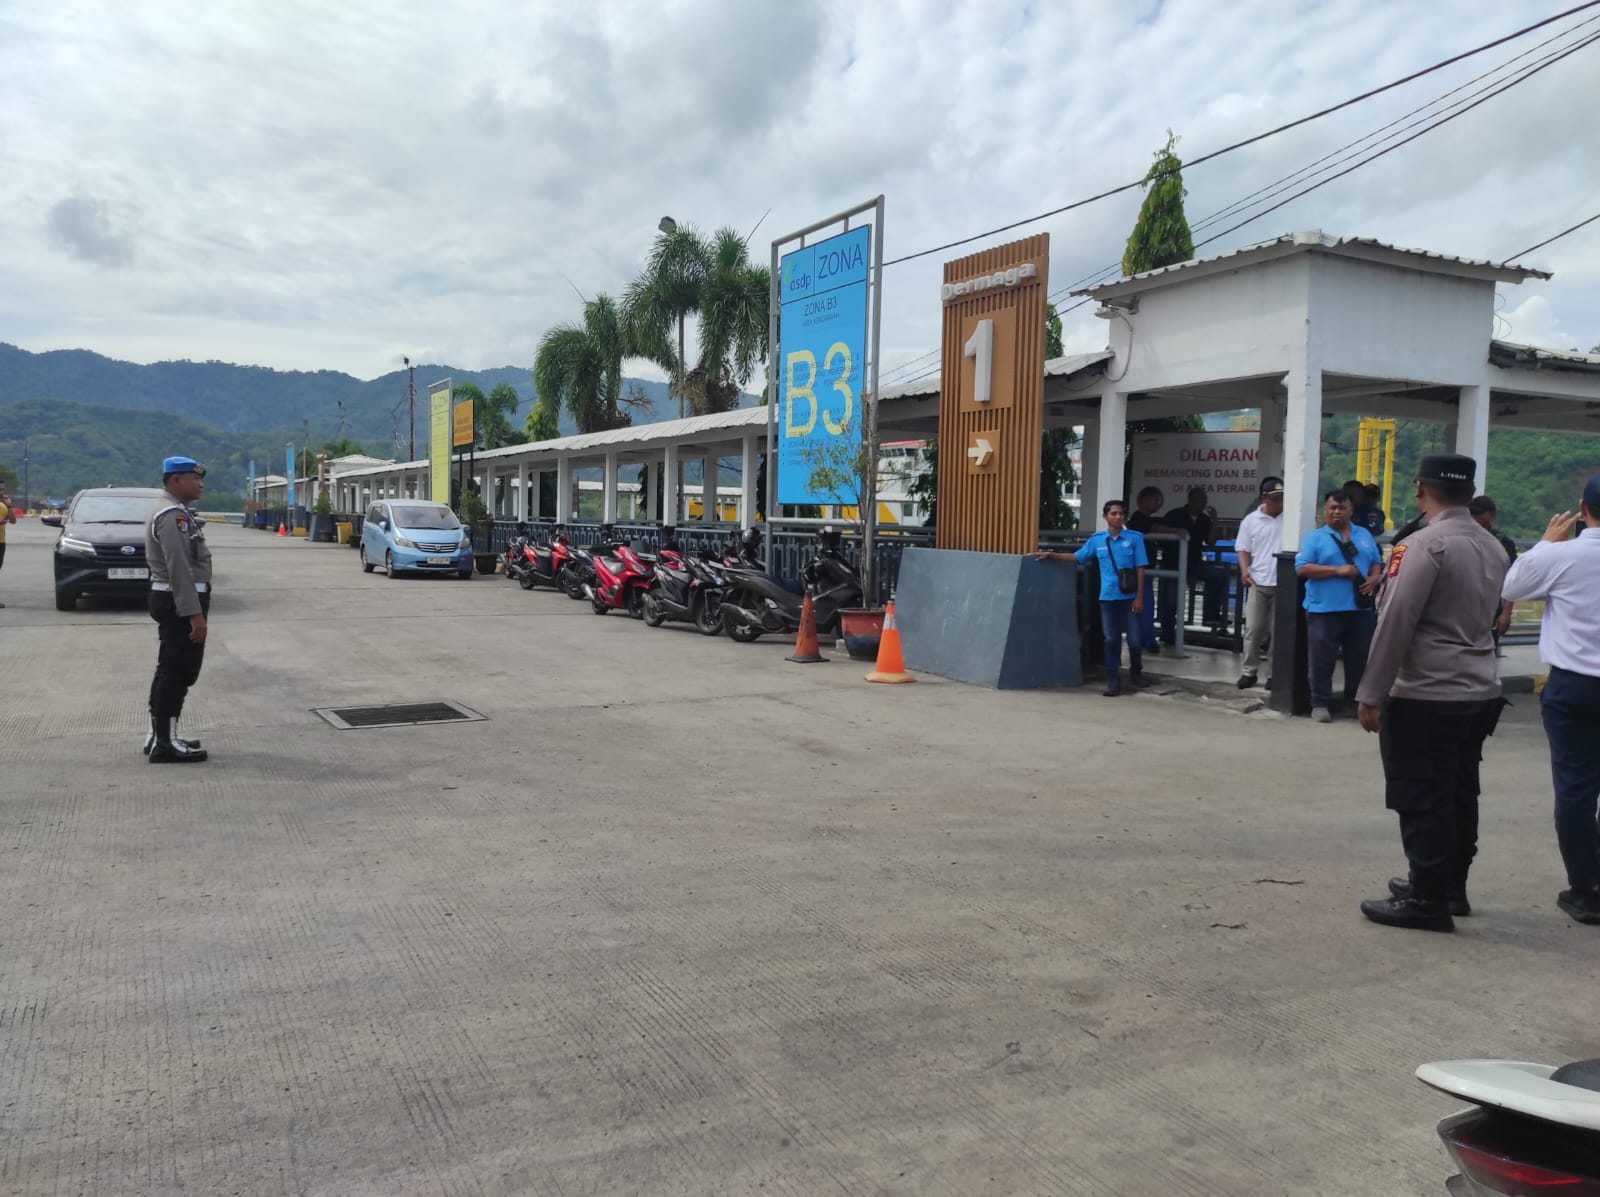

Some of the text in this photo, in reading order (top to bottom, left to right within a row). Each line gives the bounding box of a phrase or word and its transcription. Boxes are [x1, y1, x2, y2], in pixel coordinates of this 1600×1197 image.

[818, 243, 864, 280] ZONA
[790, 272, 812, 291] asdp
[941, 263, 1037, 301] Dermaga
[803, 296, 838, 317] ZONA B3
[964, 318, 993, 401] 1
[786, 342, 853, 438] B3
[1144, 468, 1211, 479] MEMANCING
[1215, 469, 1240, 479] DAN
[1172, 484, 1184, 493] DI
[1216, 484, 1256, 493] PERAIR
